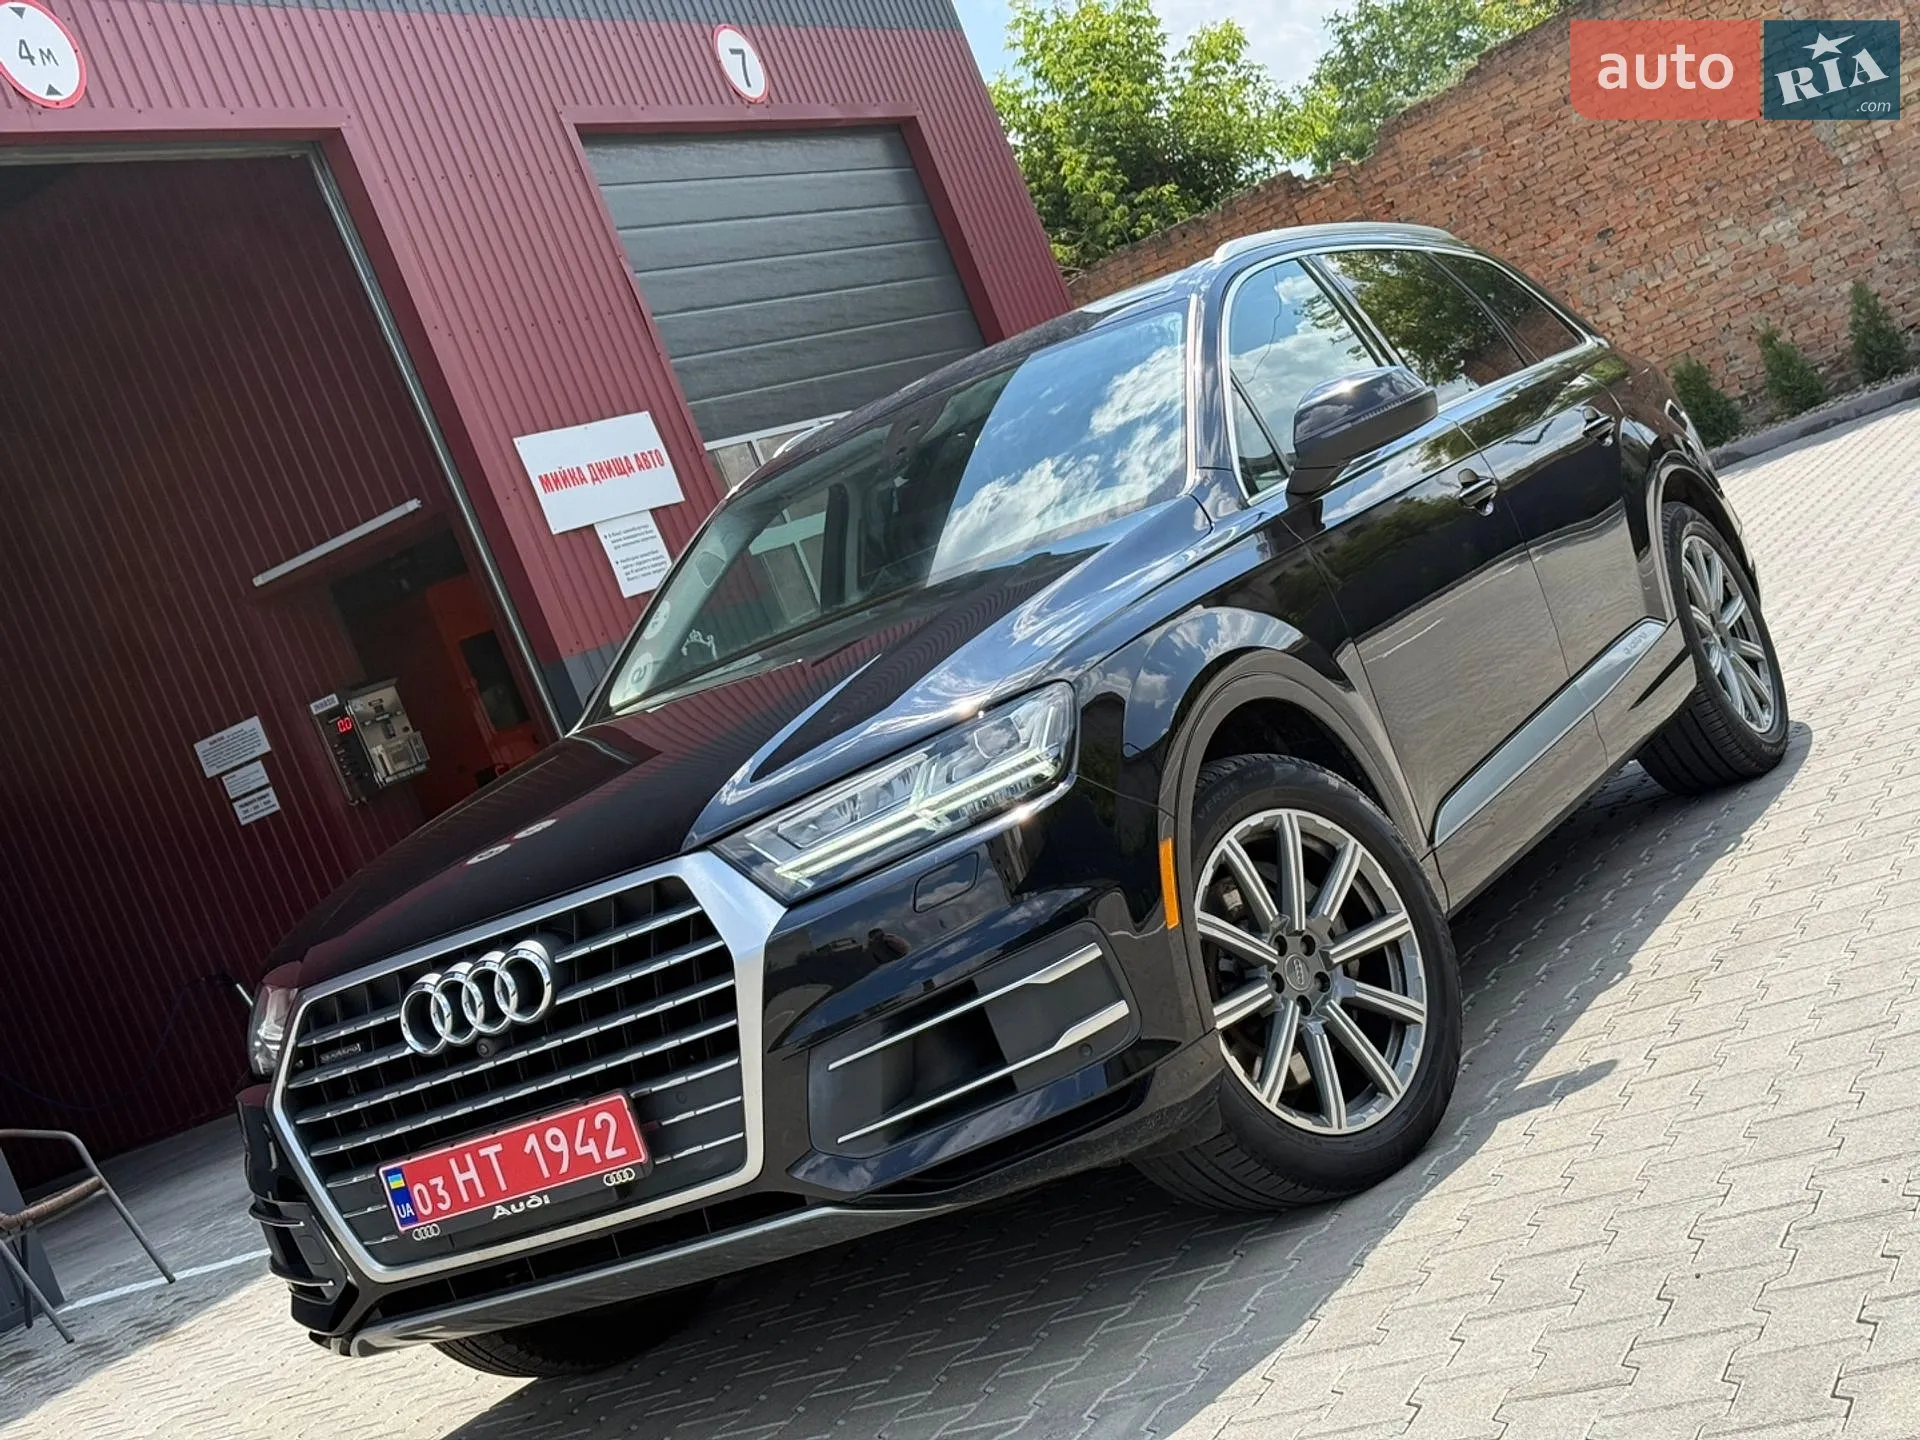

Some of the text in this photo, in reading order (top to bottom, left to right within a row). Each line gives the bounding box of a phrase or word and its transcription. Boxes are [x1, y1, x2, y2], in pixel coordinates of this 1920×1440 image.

[18, 38, 36, 66] 4
[728, 47, 752, 88] 7
[537, 448, 666, 495] МИЙКА ДНИЩА АВТО
[523, 1111, 628, 1179] 1942
[397, 1202, 416, 1220] UA
[491, 1193, 551, 1220] Audi
